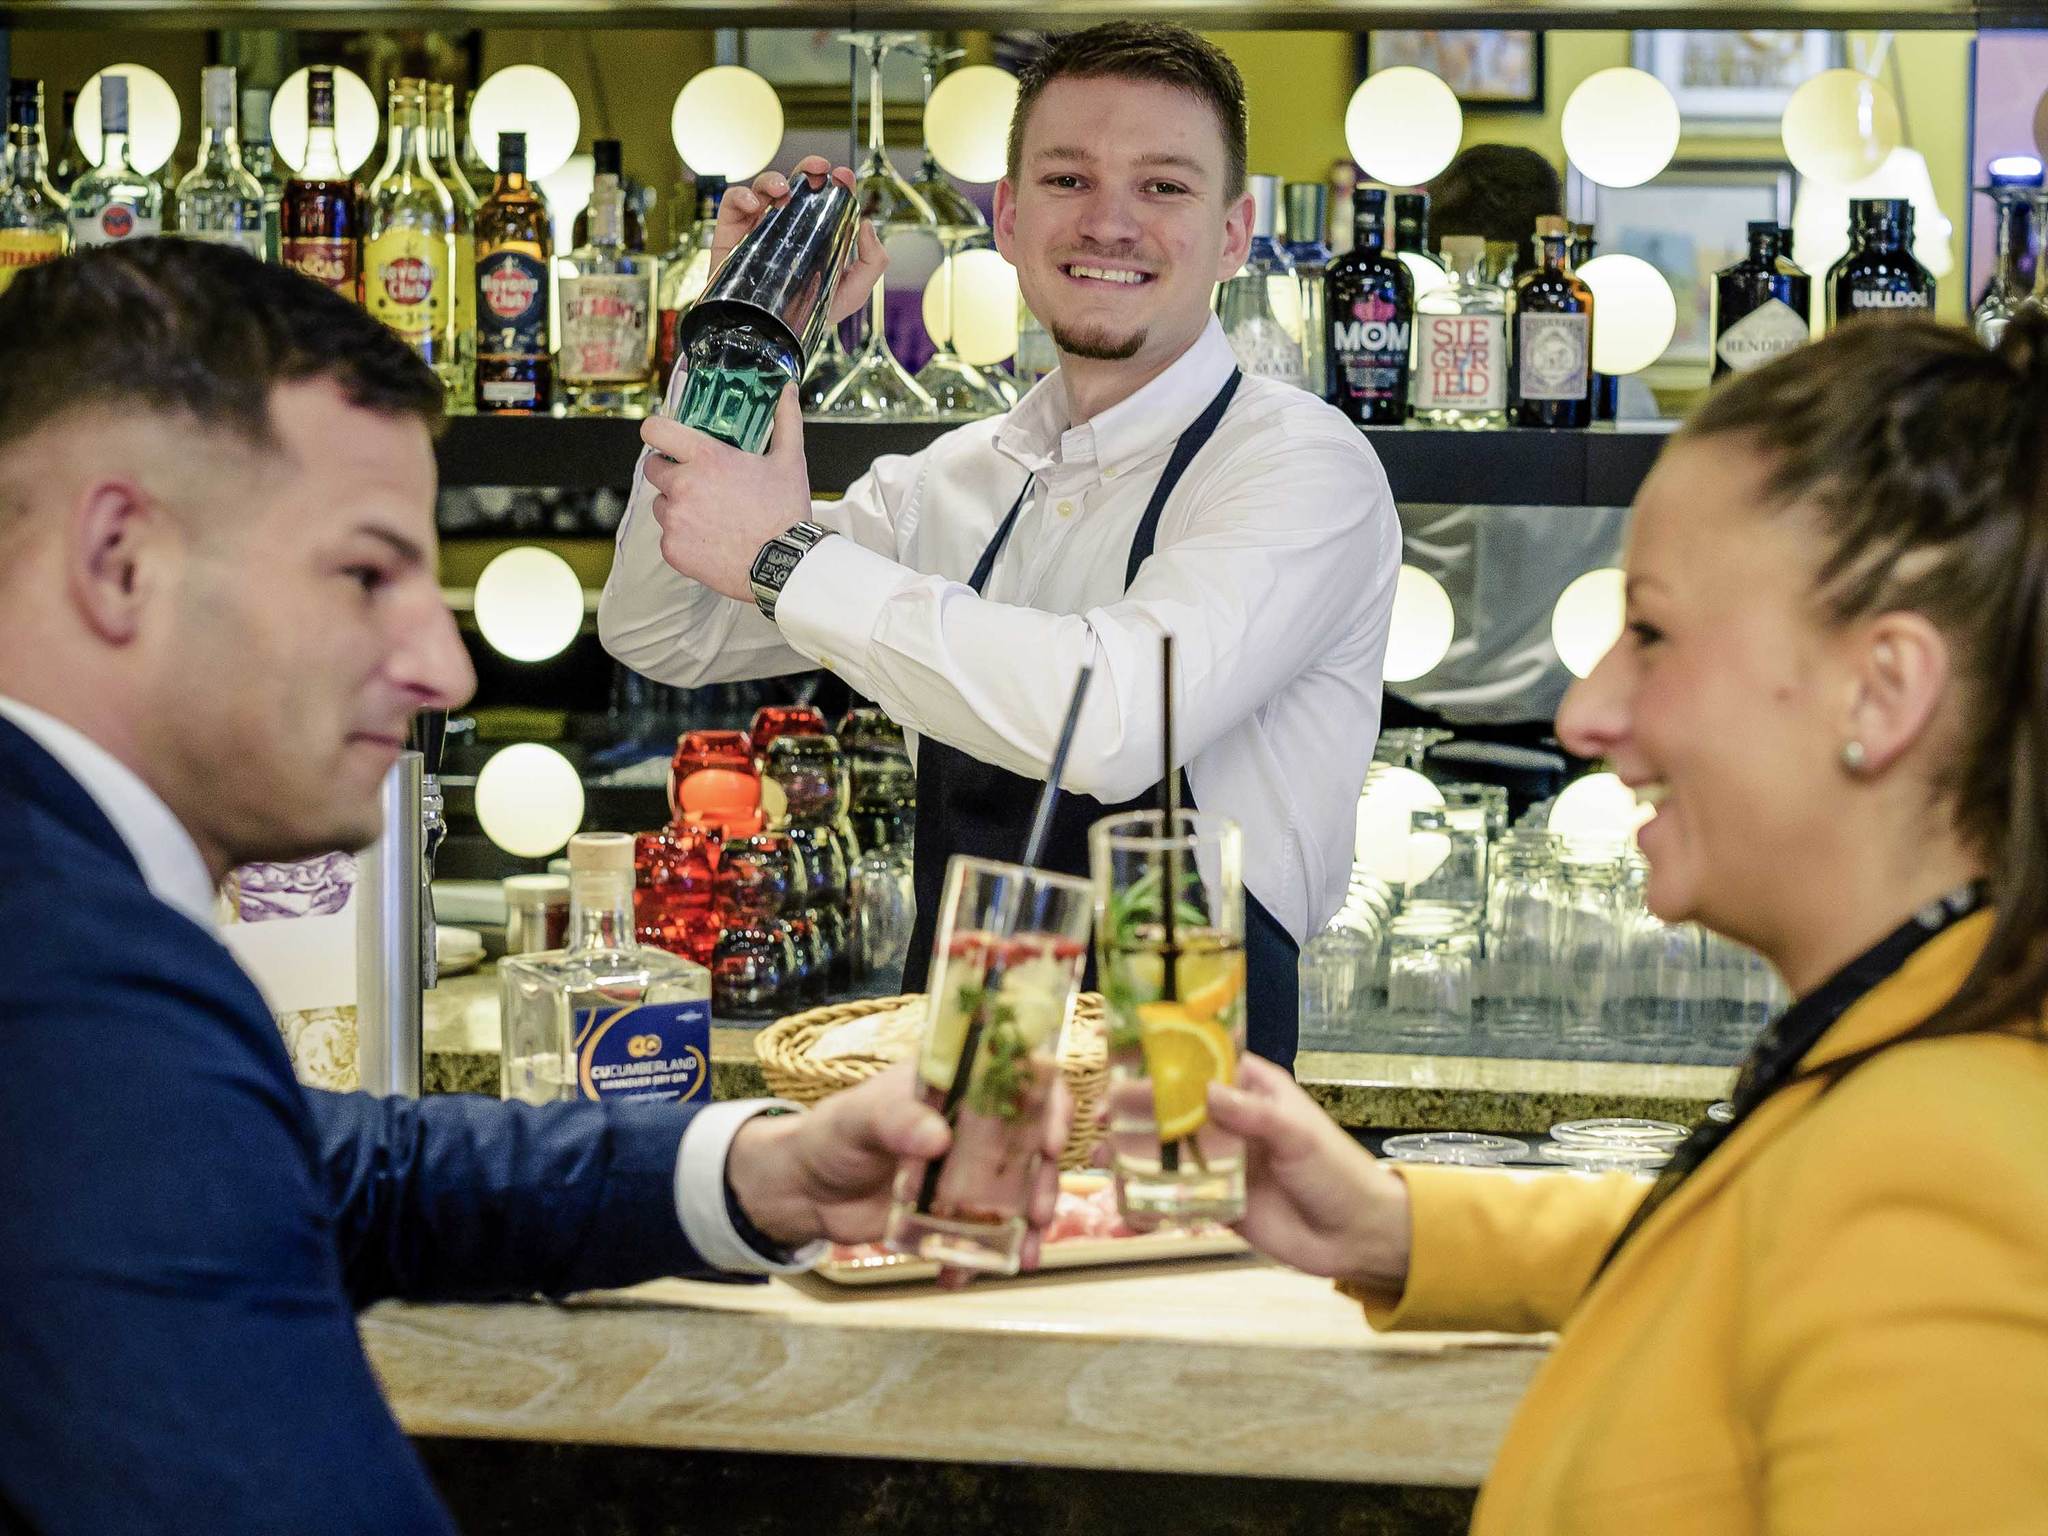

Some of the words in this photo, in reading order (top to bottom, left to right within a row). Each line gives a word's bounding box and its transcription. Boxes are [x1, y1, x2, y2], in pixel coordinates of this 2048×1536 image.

[502, 328, 516, 348] 7
[1334, 320, 1410, 351] MOM
[1432, 319, 1489, 346] SIE
[1432, 371, 1490, 396] IED
[591, 1057, 697, 1079] CUCUMBERLAND
